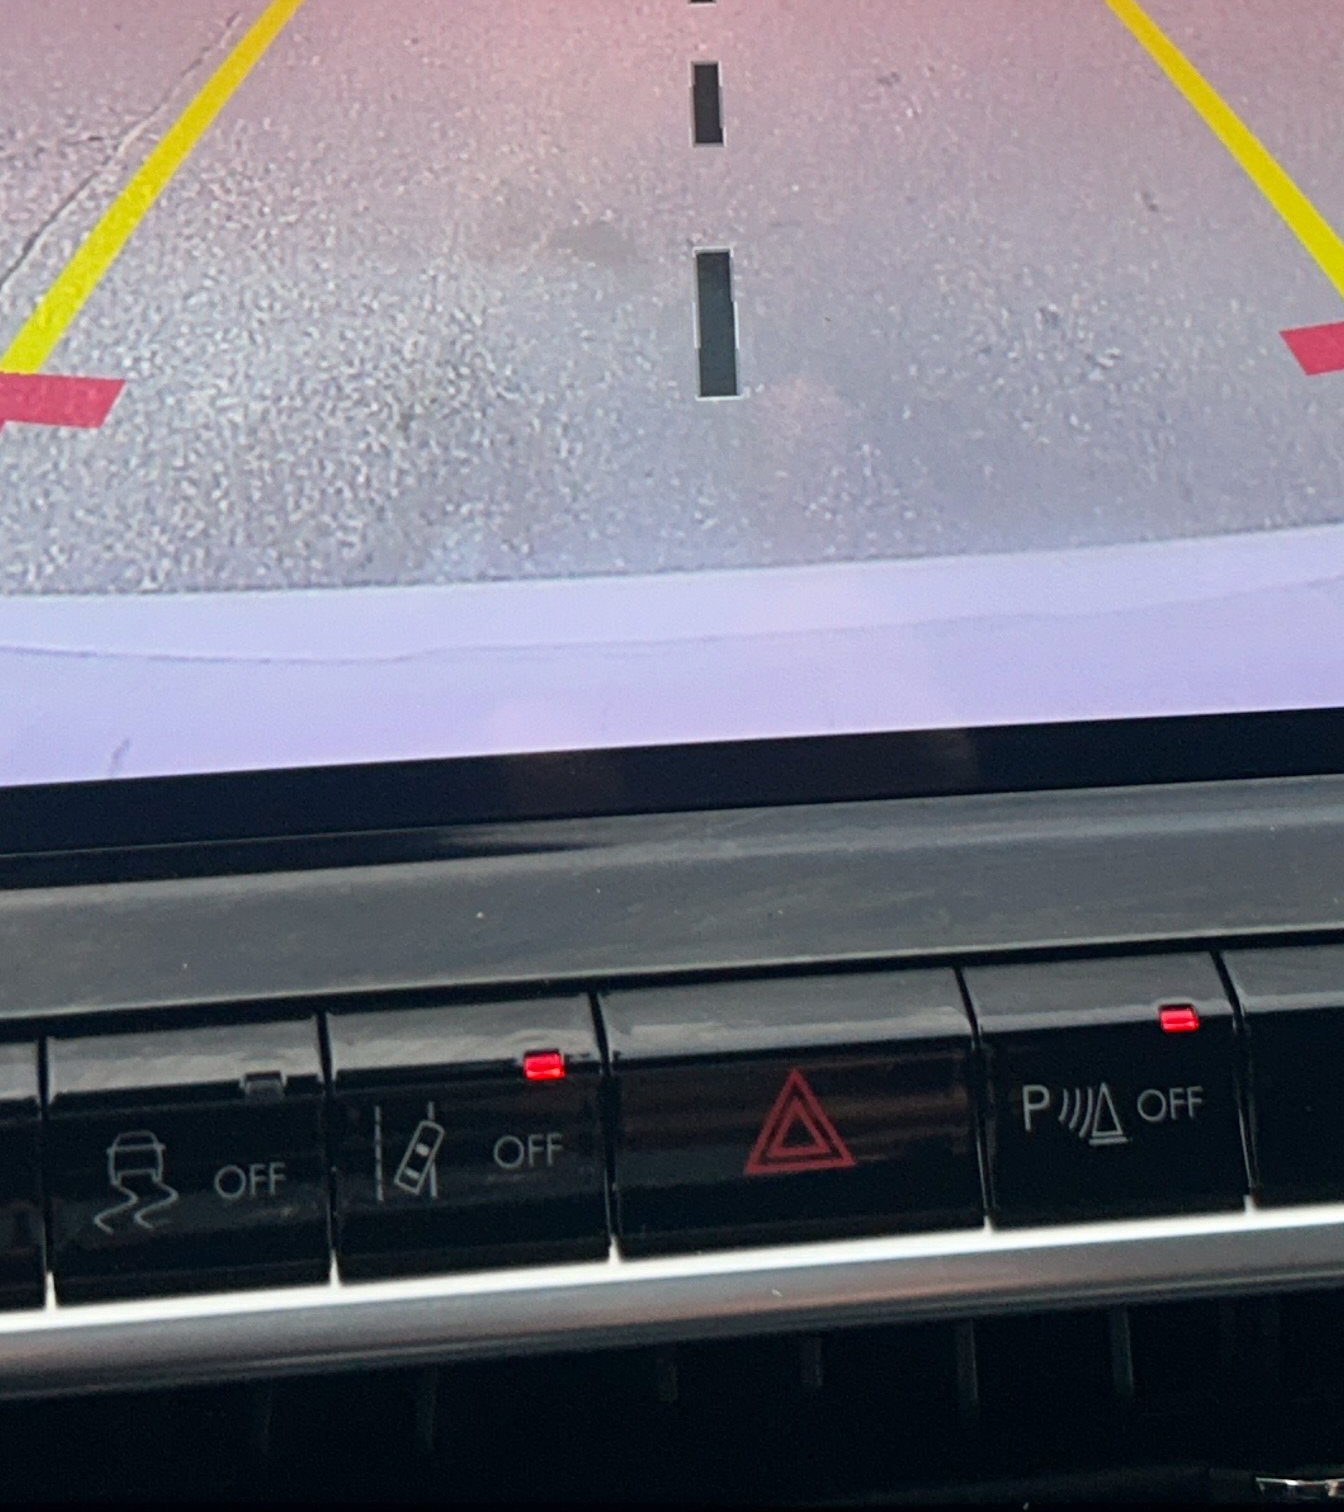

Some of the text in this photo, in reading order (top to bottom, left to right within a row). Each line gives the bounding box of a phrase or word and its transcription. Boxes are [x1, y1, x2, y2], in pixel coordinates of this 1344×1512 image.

[1022, 1083, 1204, 1132] P OFF
[493, 1132, 564, 1170] OFF
[214, 1161, 287, 1200] OFF
